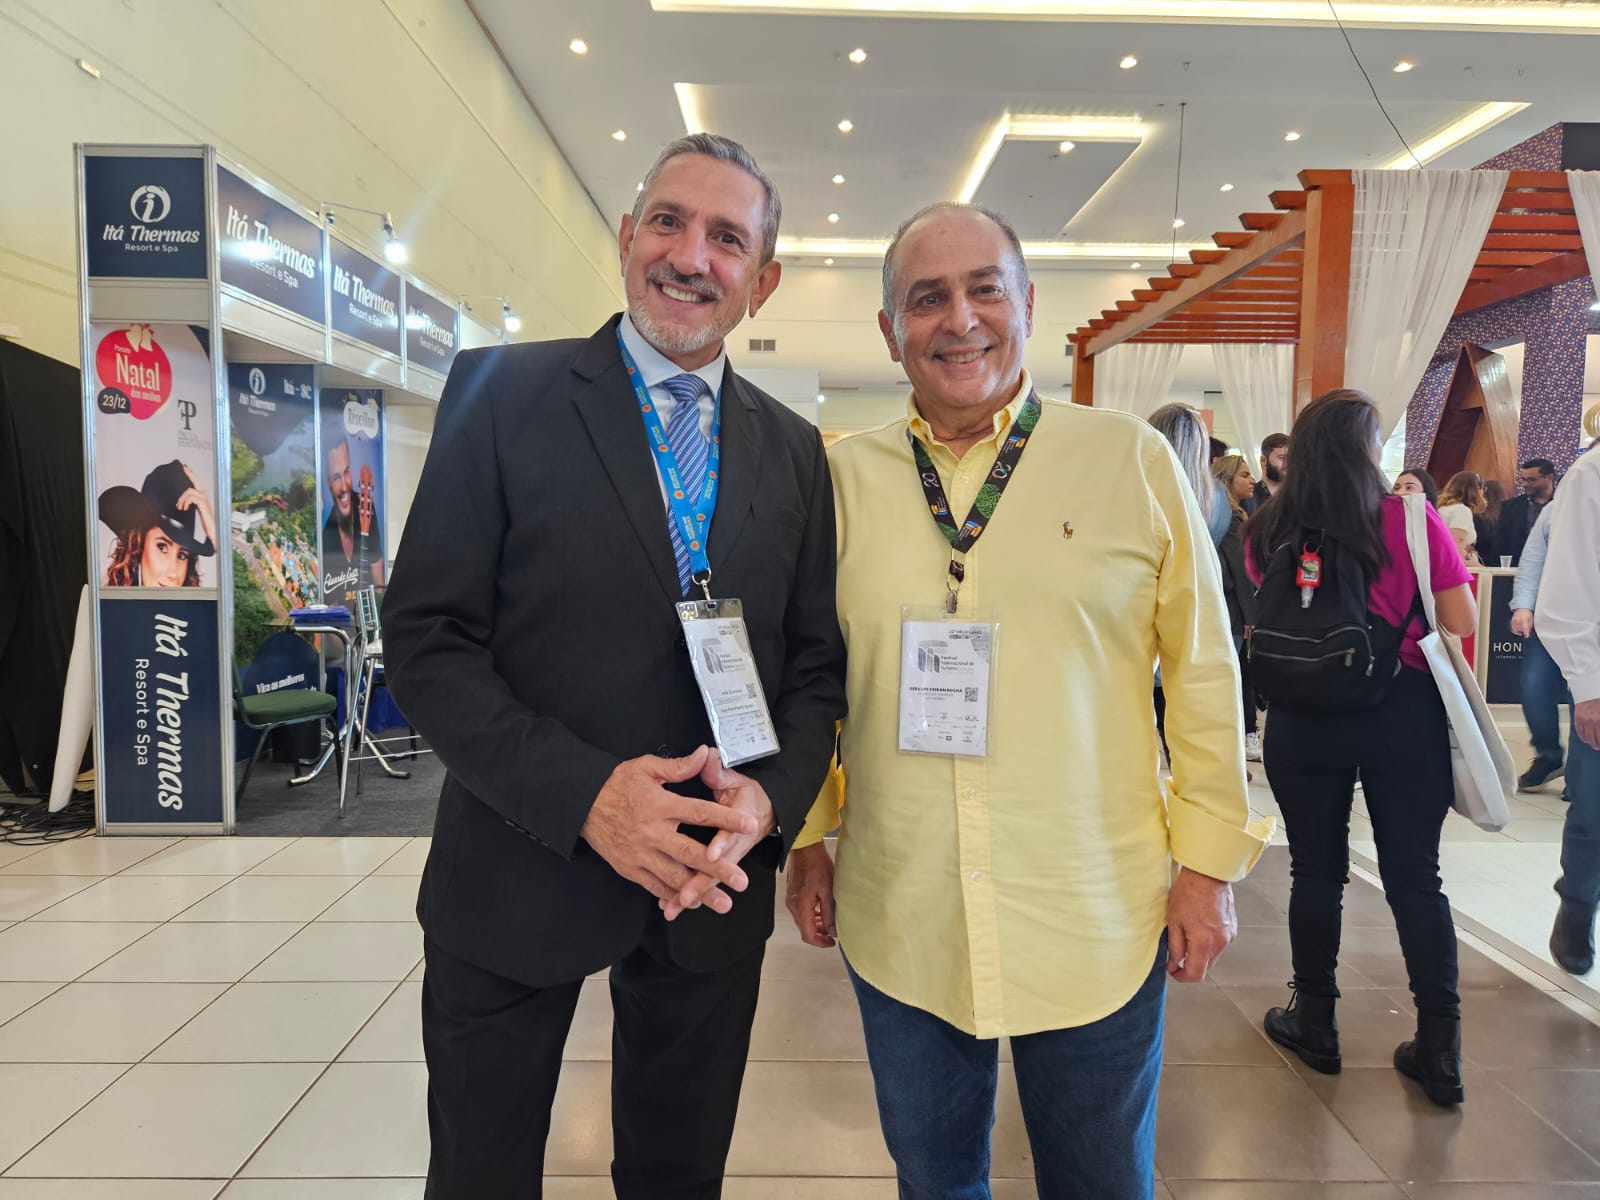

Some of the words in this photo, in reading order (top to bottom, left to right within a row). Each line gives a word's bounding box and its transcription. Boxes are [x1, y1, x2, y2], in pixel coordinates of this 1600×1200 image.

[103, 224, 125, 241] Itá
[130, 225, 200, 243] Thermas
[125, 243, 153, 252] Resort
[162, 245, 178, 254] Spa
[226, 204, 249, 242] Itá
[253, 219, 315, 279] Thermas
[277, 270, 283, 280] e
[283, 270, 299, 288] Spa
[333, 264, 350, 297] Itá
[352, 275, 395, 319] Thermas
[349, 302, 368, 322] Resort
[422, 313, 454, 348] Thermas
[116, 353, 160, 391] Natal
[102, 394, 127, 409] 23/12
[300, 384, 312, 400] SC
[154, 613, 189, 657] Itá
[135, 658, 150, 715] Resort
[136, 719, 148, 729] e
[133, 734, 151, 765] Spa
[155, 672, 190, 811] Thermas
